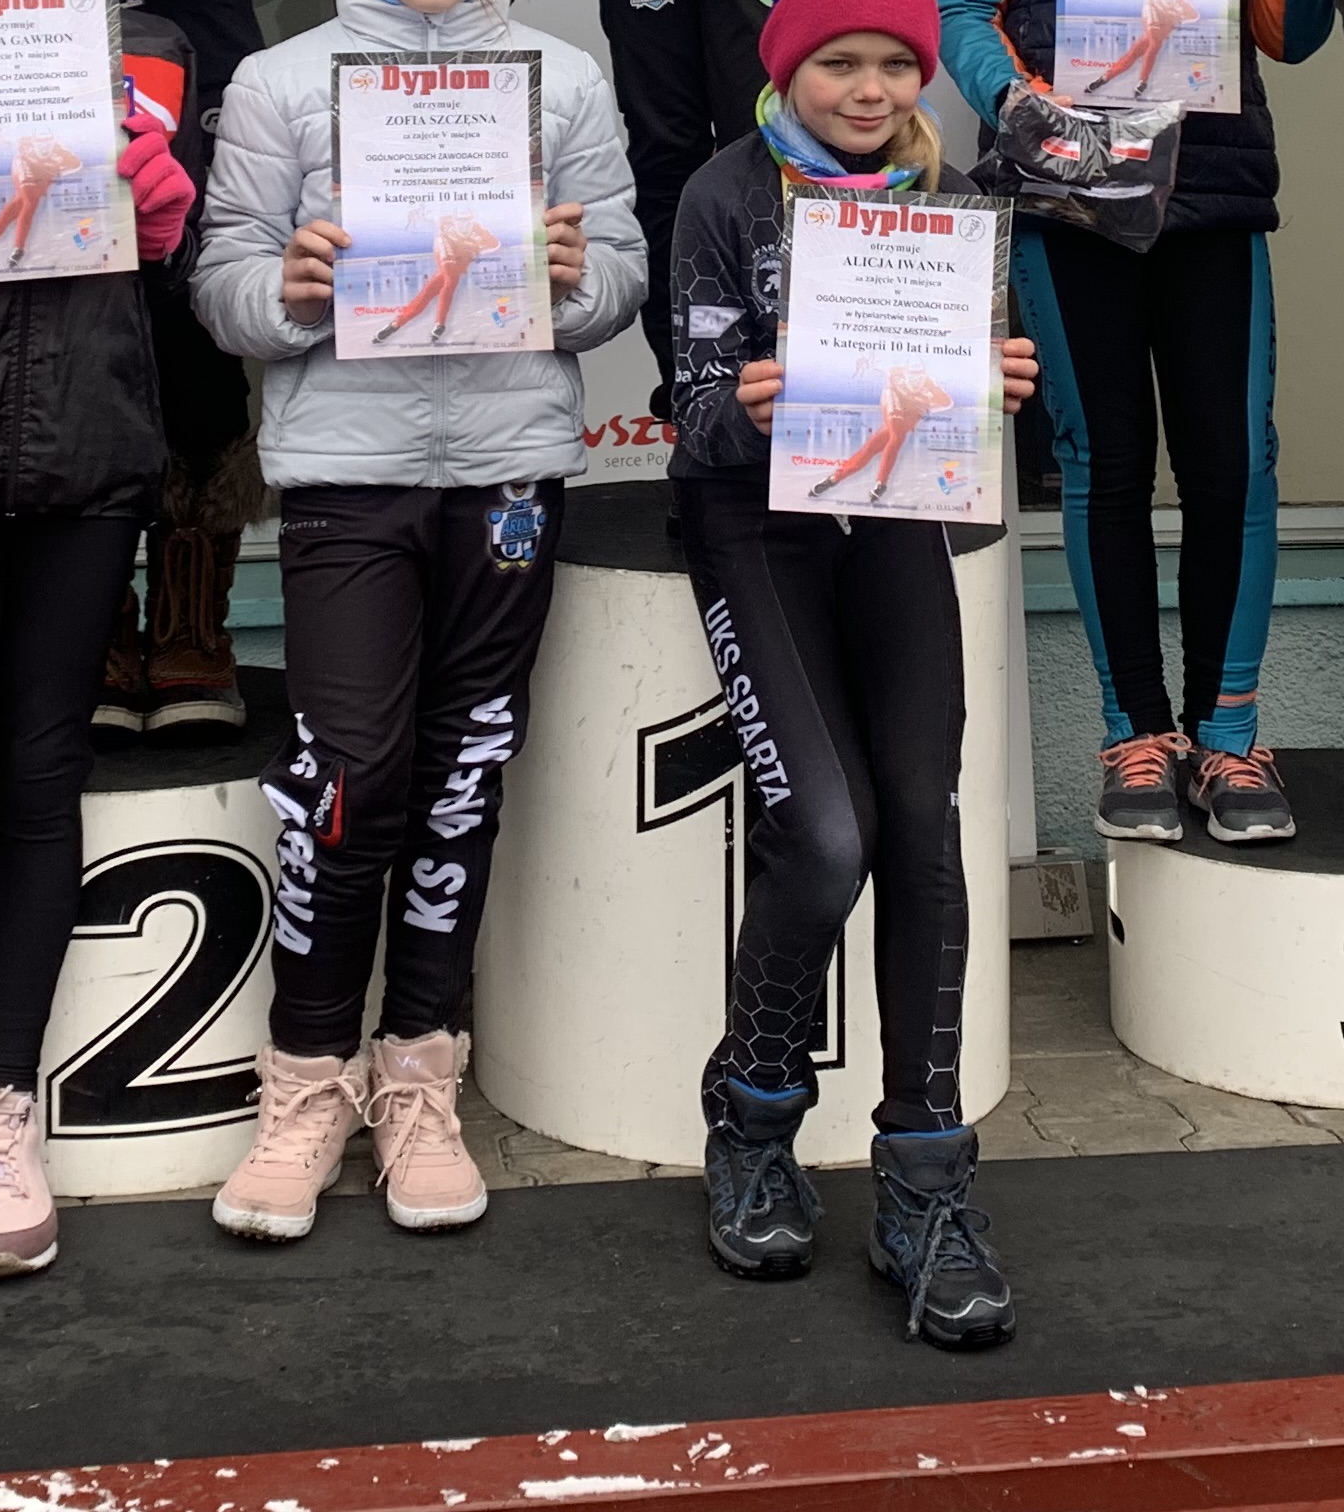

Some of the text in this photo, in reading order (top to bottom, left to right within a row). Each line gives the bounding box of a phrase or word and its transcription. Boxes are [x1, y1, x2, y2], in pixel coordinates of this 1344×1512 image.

[10, 33, 72, 44] GAWRON
[382, 65, 490, 95] Dyplom
[57, 109, 95, 120] młodsi
[385, 114, 496, 126] ZOFIA SZCZĘSNA
[384, 192, 434, 203] kategorii
[478, 190, 513, 200] młodsi
[838, 201, 954, 237] Dyplom
[843, 255, 956, 272] ALICJA IWANEK
[832, 338, 886, 352] kategorii
[890, 341, 903, 351] 10
[906, 342, 922, 352] lat
[933, 343, 972, 355] młodsi
[604, 451, 670, 468] serce Pol
[706, 597, 792, 808] UKS SPARTA
[403, 857, 467, 933] KS
[46, 839, 274, 1141] 2
